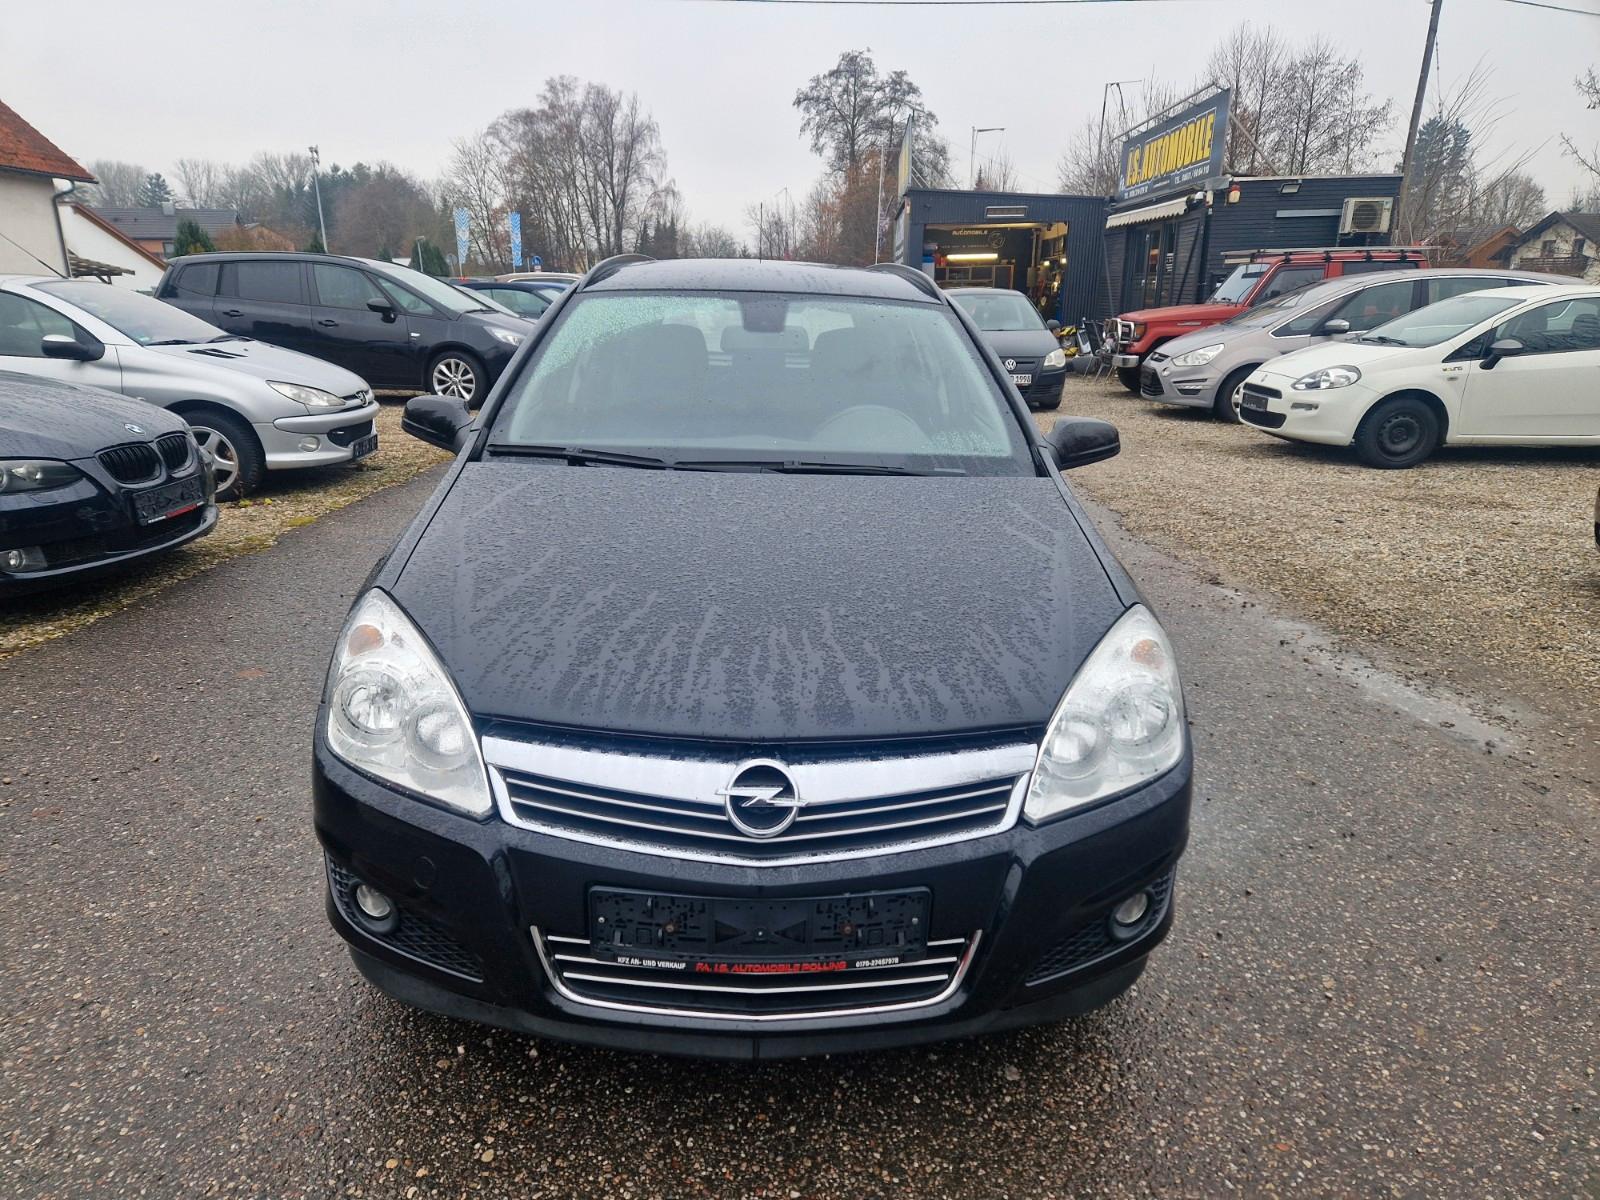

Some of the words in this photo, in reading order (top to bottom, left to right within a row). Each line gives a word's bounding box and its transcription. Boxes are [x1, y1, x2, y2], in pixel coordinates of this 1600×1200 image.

[1141, 112, 1215, 181] AUTOMOBILE
[1015, 375, 1031, 383] 1998
[617, 956, 630, 964] KFZ
[642, 959, 657, 967] UND
[657, 960, 686, 970] VERKAUF
[731, 963, 801, 974] AUTOMOBILE
[802, 960, 848, 972] POLLING
